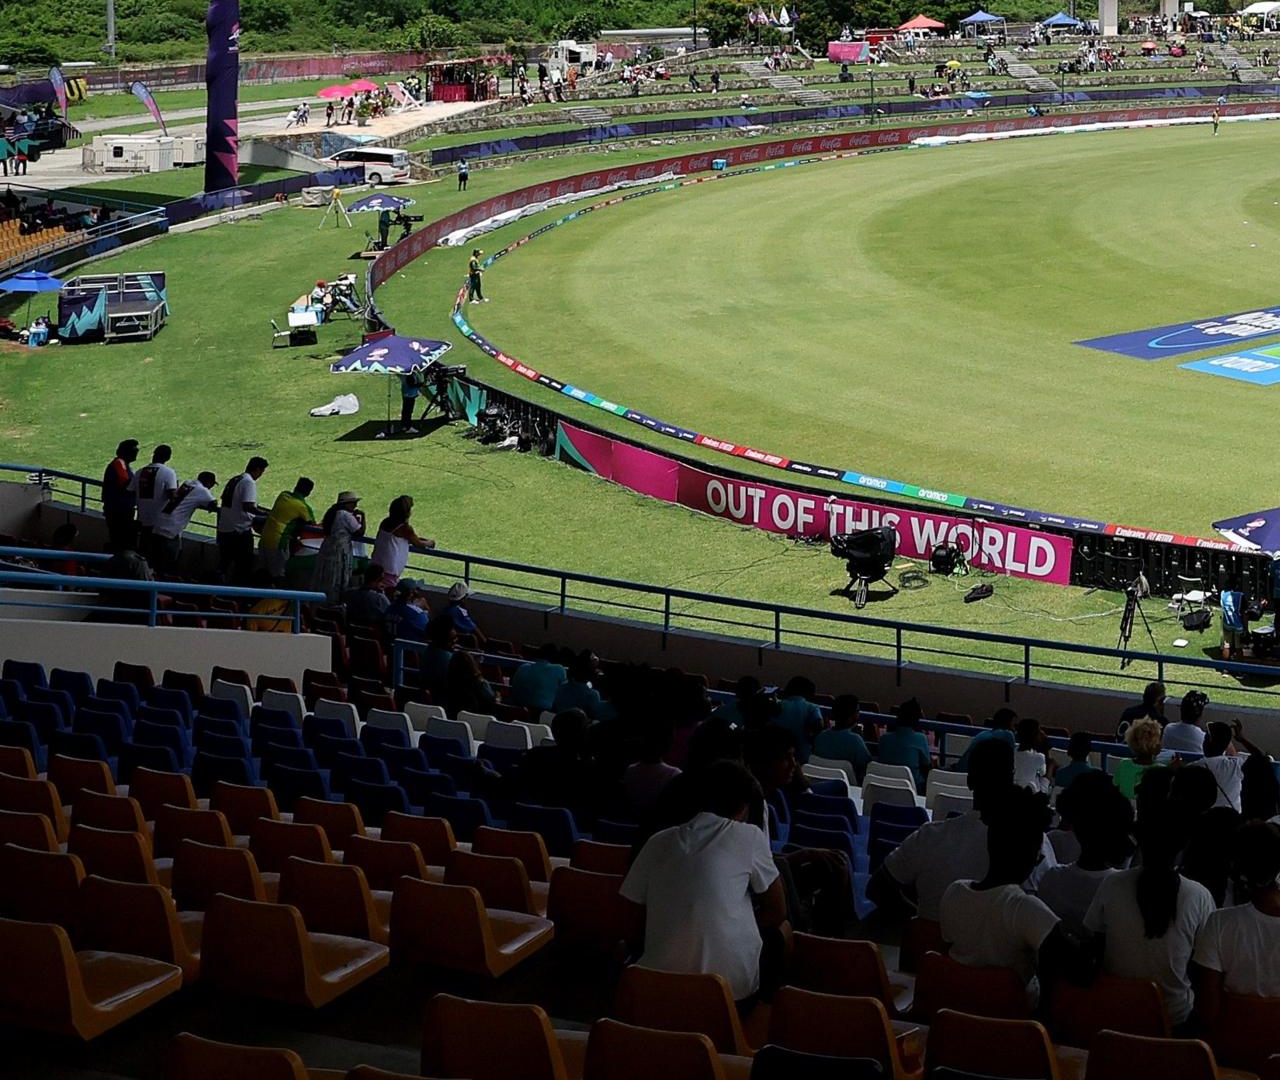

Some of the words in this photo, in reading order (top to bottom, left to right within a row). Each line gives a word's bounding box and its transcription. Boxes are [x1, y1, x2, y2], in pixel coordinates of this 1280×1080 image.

[707, 479, 765, 524] OUT
[772, 494, 815, 532] OF
[824, 501, 900, 548] THIS
[911, 517, 1056, 576] WORLD
[1115, 527, 1147, 539] Emirates
